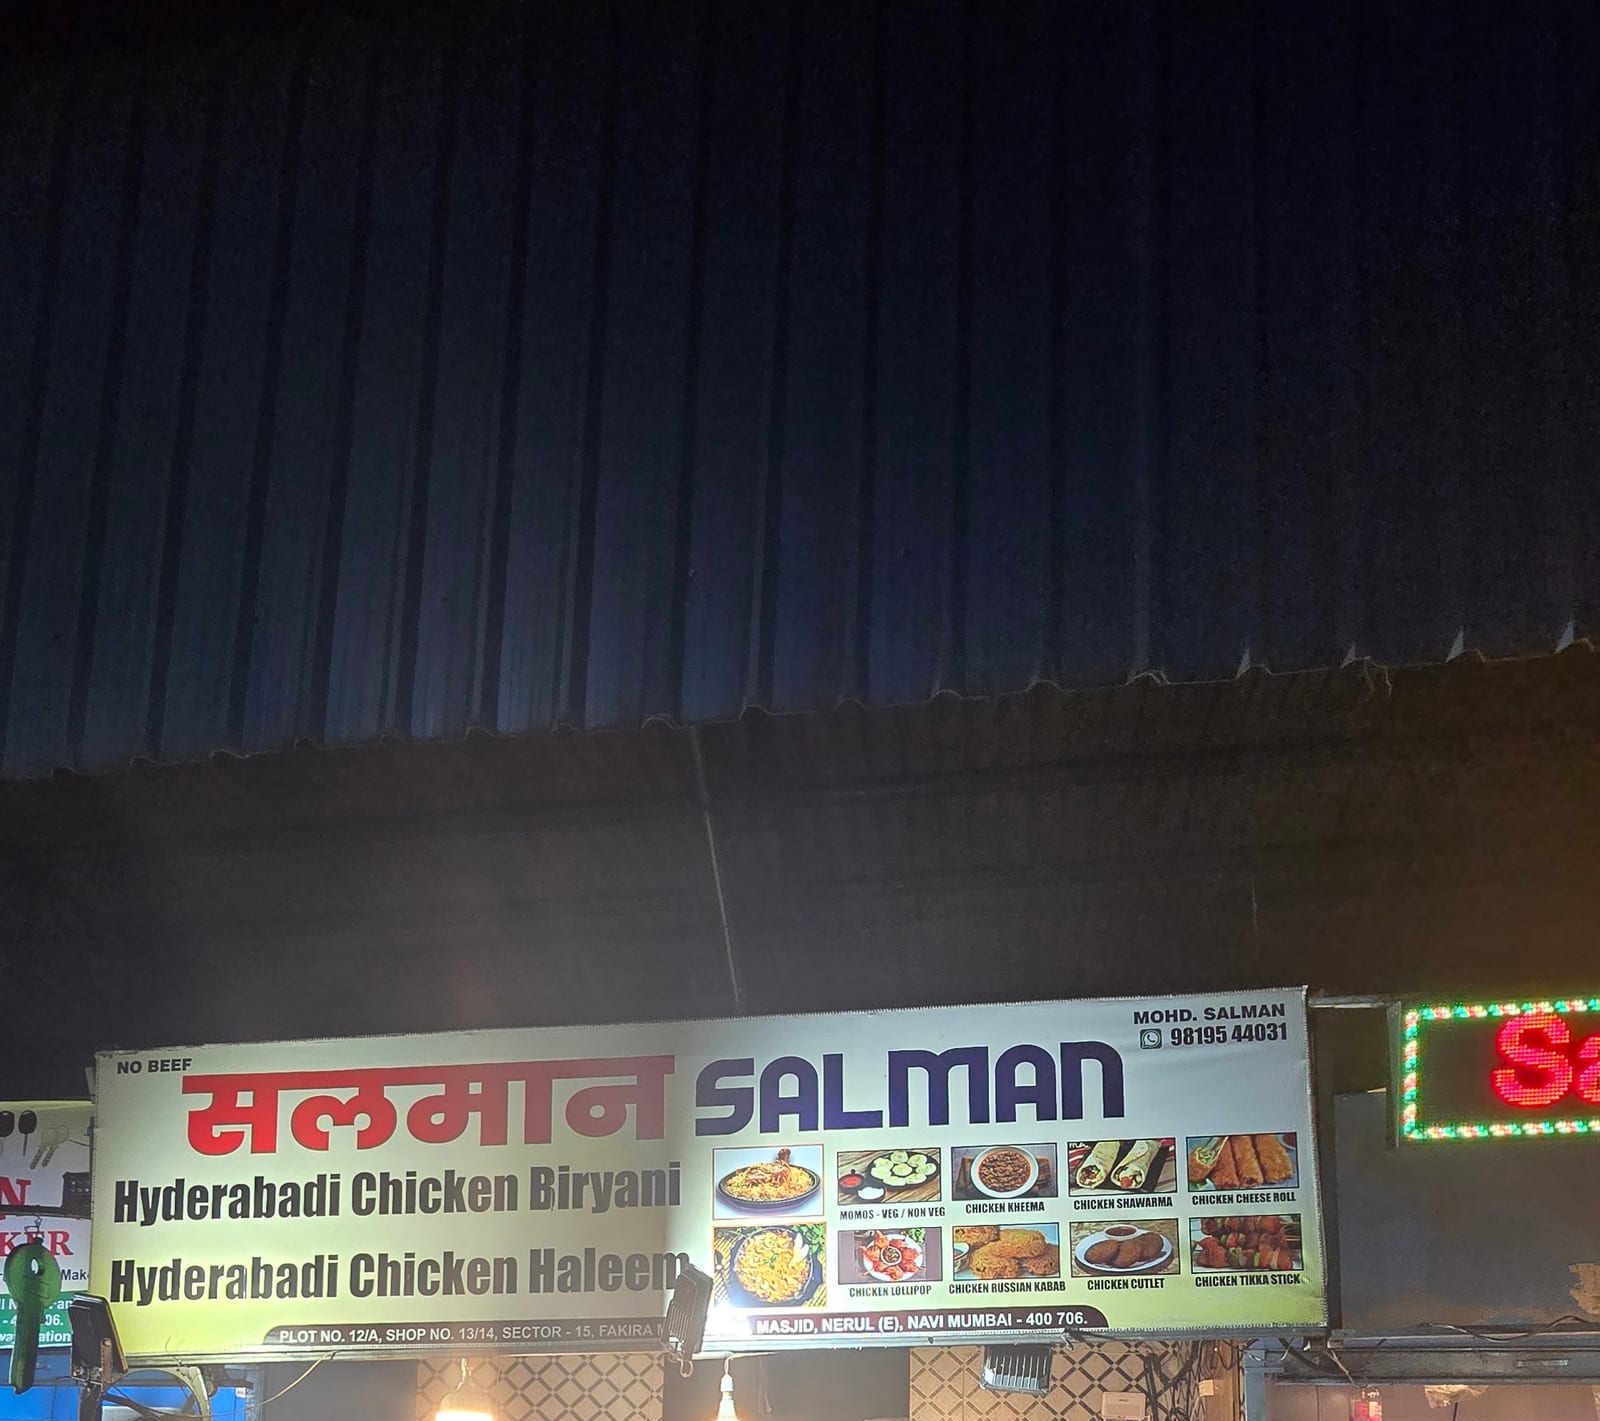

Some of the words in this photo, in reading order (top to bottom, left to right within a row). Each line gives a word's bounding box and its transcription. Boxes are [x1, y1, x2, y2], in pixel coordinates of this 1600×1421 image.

[1133, 1009, 1198, 1025] MOHD.
[1203, 1003, 1286, 1021] SALMAN
[1170, 1026, 1227, 1047] 98195
[1231, 1022, 1288, 1043] 44031
[116, 1060, 142, 1075] NO
[147, 1057, 193, 1074] BEEF
[695, 1040, 1126, 1137] SALMAN
[181, 1054, 676, 1157] सलमान
[113, 1173, 342, 1227] Hyderabadi
[351, 1168, 519, 1217] Chicken
[529, 1161, 681, 1214] Biryani
[1073, 1198, 1115, 1210] CHICKEN
[1116, 1196, 1174, 1209] SHAWARMA
[1191, 1194, 1234, 1206] CHICKEN
[1236, 1193, 1272, 1204] CHEESE
[1273, 1191, 1297, 1202] ROLL
[839, 1210, 875, 1220] MOMOS
[882, 1209, 899, 1219] VEG
[907, 1207, 927, 1218] NON
[928, 1206, 946, 1217] VEG
[965, 1202, 1006, 1214] CHICKEN
[1007, 1201, 1045, 1213] KHEEMA
[110, 1254, 339, 1307] Hyderabadi
[349, 1251, 518, 1298] Chicken
[528, 1247, 690, 1294] Haleem
[1087, 1278, 1129, 1290] CHICKEN
[1130, 1277, 1165, 1289] CUTLET
[1195, 1275, 1238, 1287] CHICKEN
[1239, 1274, 1269, 1286] TIKKA
[1271, 1273, 1301, 1285] STICK
[849, 1286, 889, 1297] CHICKEN
[891, 1284, 932, 1296] LOLLIPOP
[948, 1283, 990, 1294] CHICKEN
[991, 1282, 1032, 1293] RUSSIAN
[1033, 1280, 1066, 1292] KABAB
[756, 1319, 818, 1335] MASJID,
[821, 1317, 875, 1332] NERUL
[878, 1316, 904, 1333] (E),
[907, 1314, 944, 1329] NAVI
[946, 1313, 1013, 1328] MUMBAI
[1025, 1312, 1053, 1326] 400
[1056, 1311, 1088, 1325] 706.
[279, 1329, 318, 1343] PLOT
[320, 1329, 345, 1342] NO.
[349, 1329, 383, 1343] 12/A,
[386, 1328, 427, 1341] SHOP
[430, 1328, 454, 1341] NO.
[458, 1326, 498, 1342] 13/14,
[502, 1326, 562, 1339] SECTOR
[575, 1325, 595, 1338] 15,
[599, 1323, 654, 1337] FAKIRA
